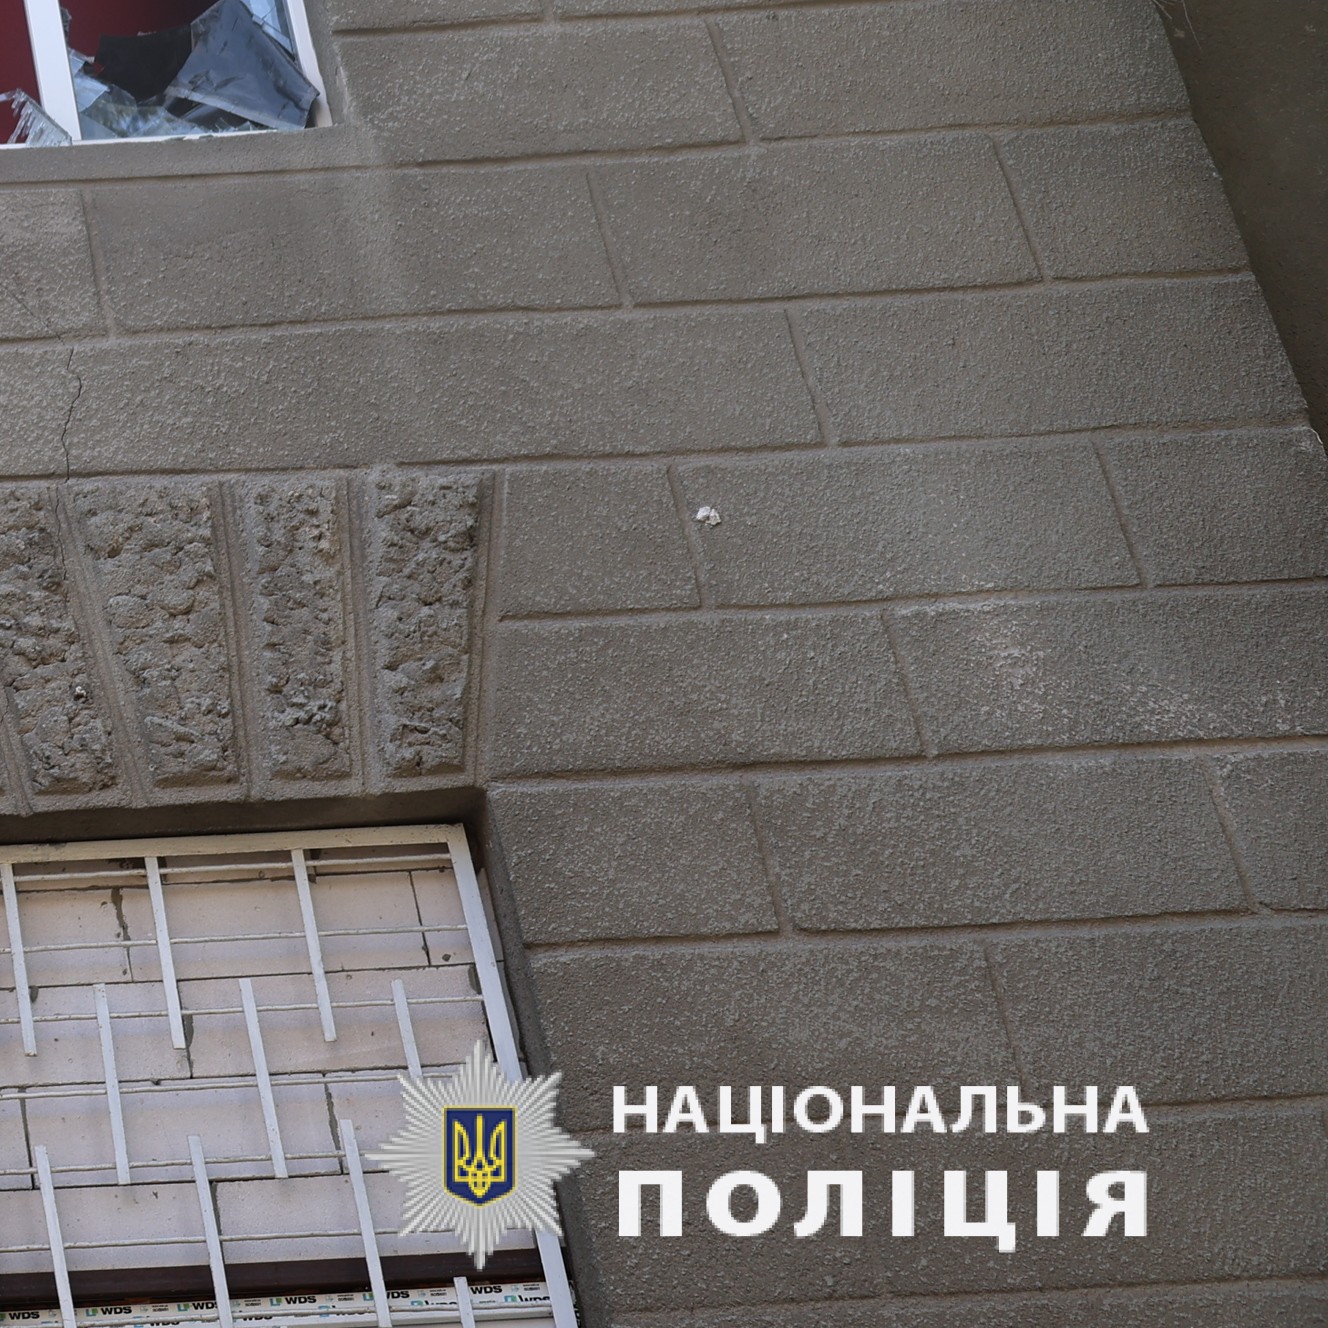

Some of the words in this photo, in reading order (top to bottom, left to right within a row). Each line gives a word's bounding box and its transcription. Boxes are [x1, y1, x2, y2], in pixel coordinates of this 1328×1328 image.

[470, 1285, 503, 1294] WDS
[386, 1290, 410, 1299] DS
[285, 1295, 317, 1305] WDS
[100, 1306, 133, 1315] WDS
[8, 1311, 40, 1320] WDS
